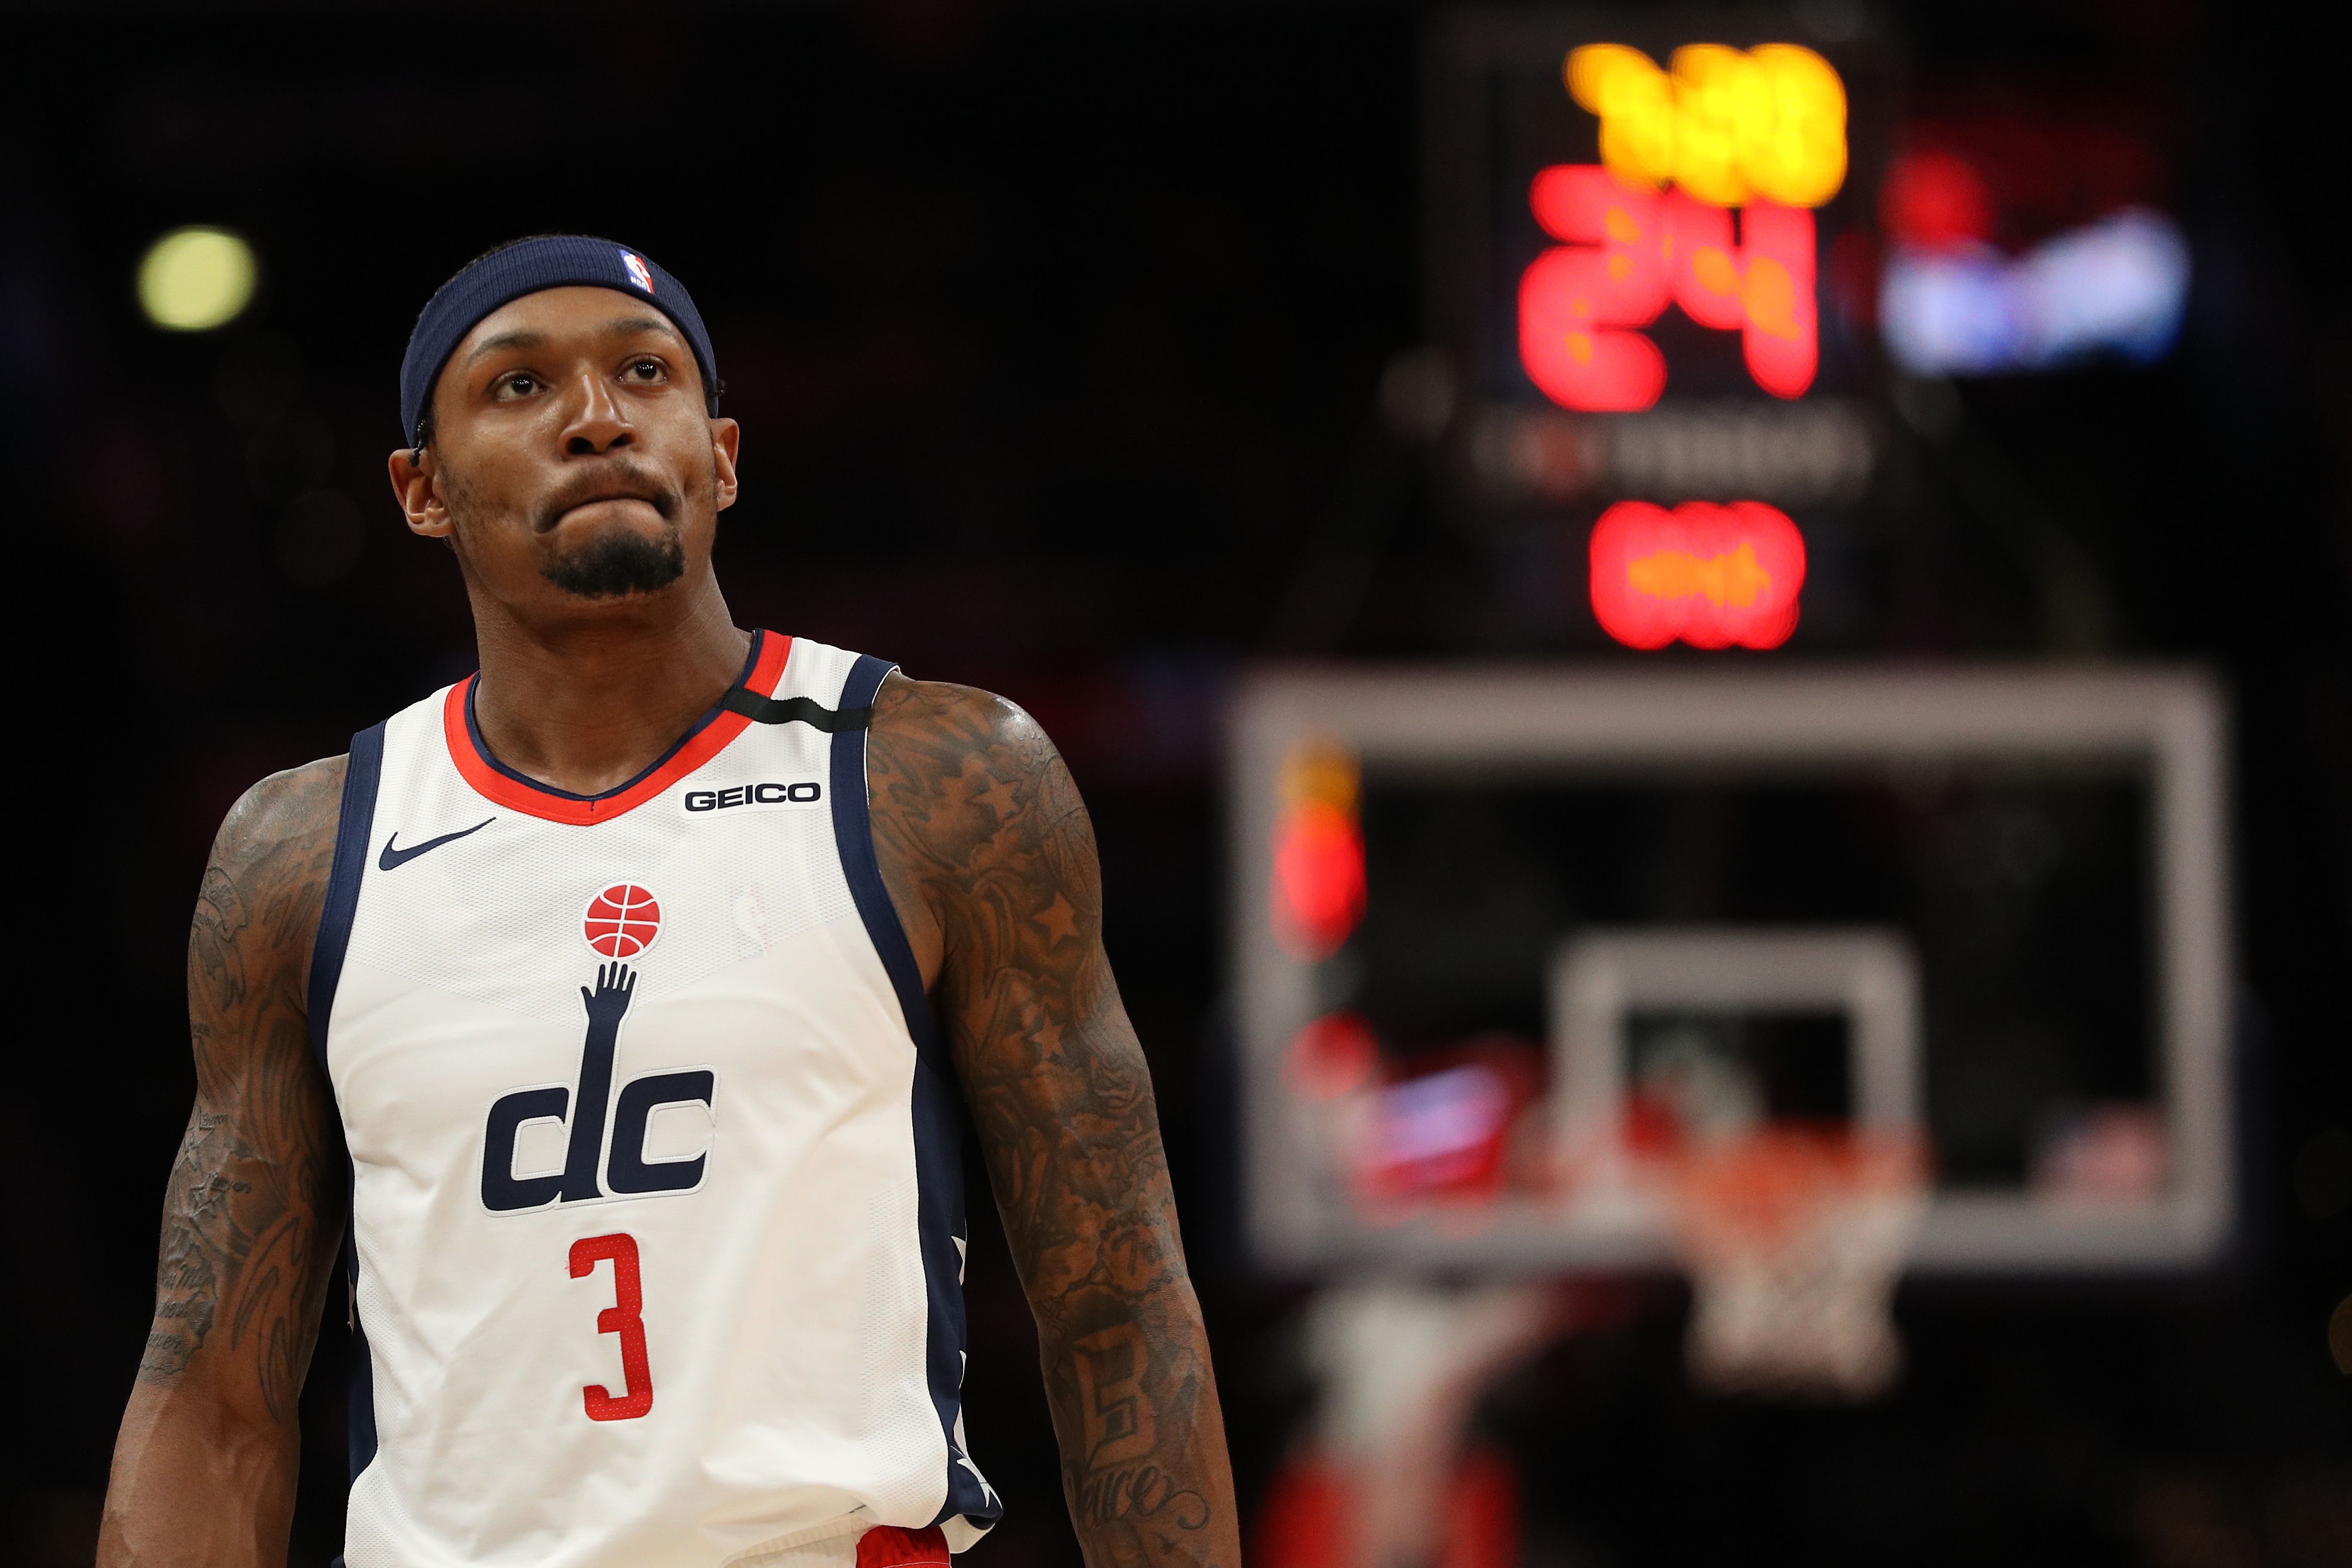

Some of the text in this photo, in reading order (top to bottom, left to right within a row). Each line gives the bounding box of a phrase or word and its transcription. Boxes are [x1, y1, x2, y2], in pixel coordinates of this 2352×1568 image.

[630, 276, 648, 291] NBA
[685, 782, 821, 812] GEICO
[481, 961, 714, 1212] dc
[569, 1232, 653, 1422] 3
